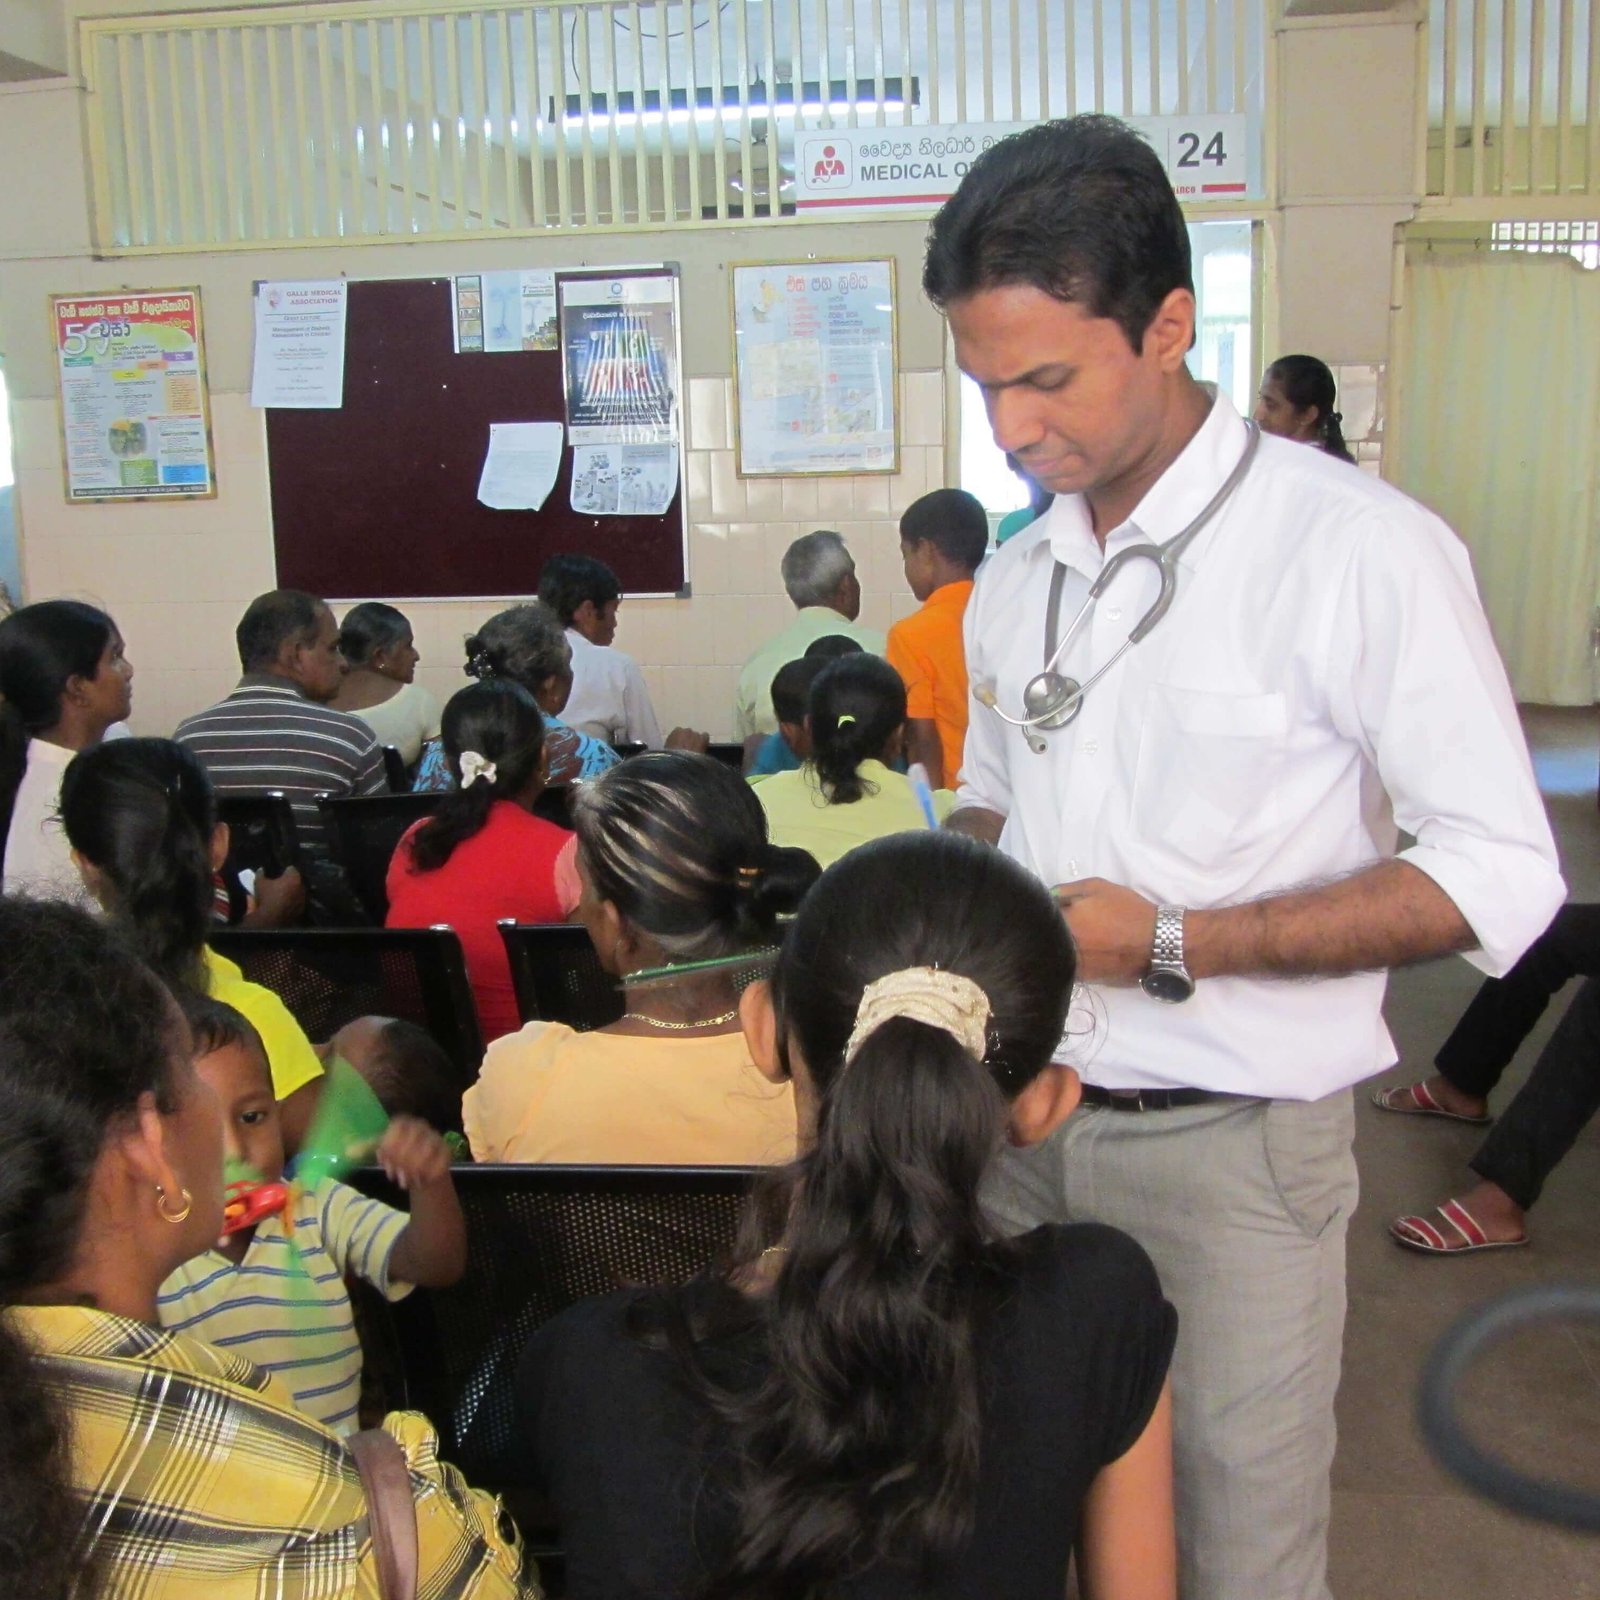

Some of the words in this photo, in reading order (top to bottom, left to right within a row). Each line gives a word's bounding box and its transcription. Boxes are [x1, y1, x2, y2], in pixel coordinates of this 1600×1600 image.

[1177, 131, 1227, 168] 24
[860, 162, 948, 182] MEDICAL
[953, 161, 974, 178] O
